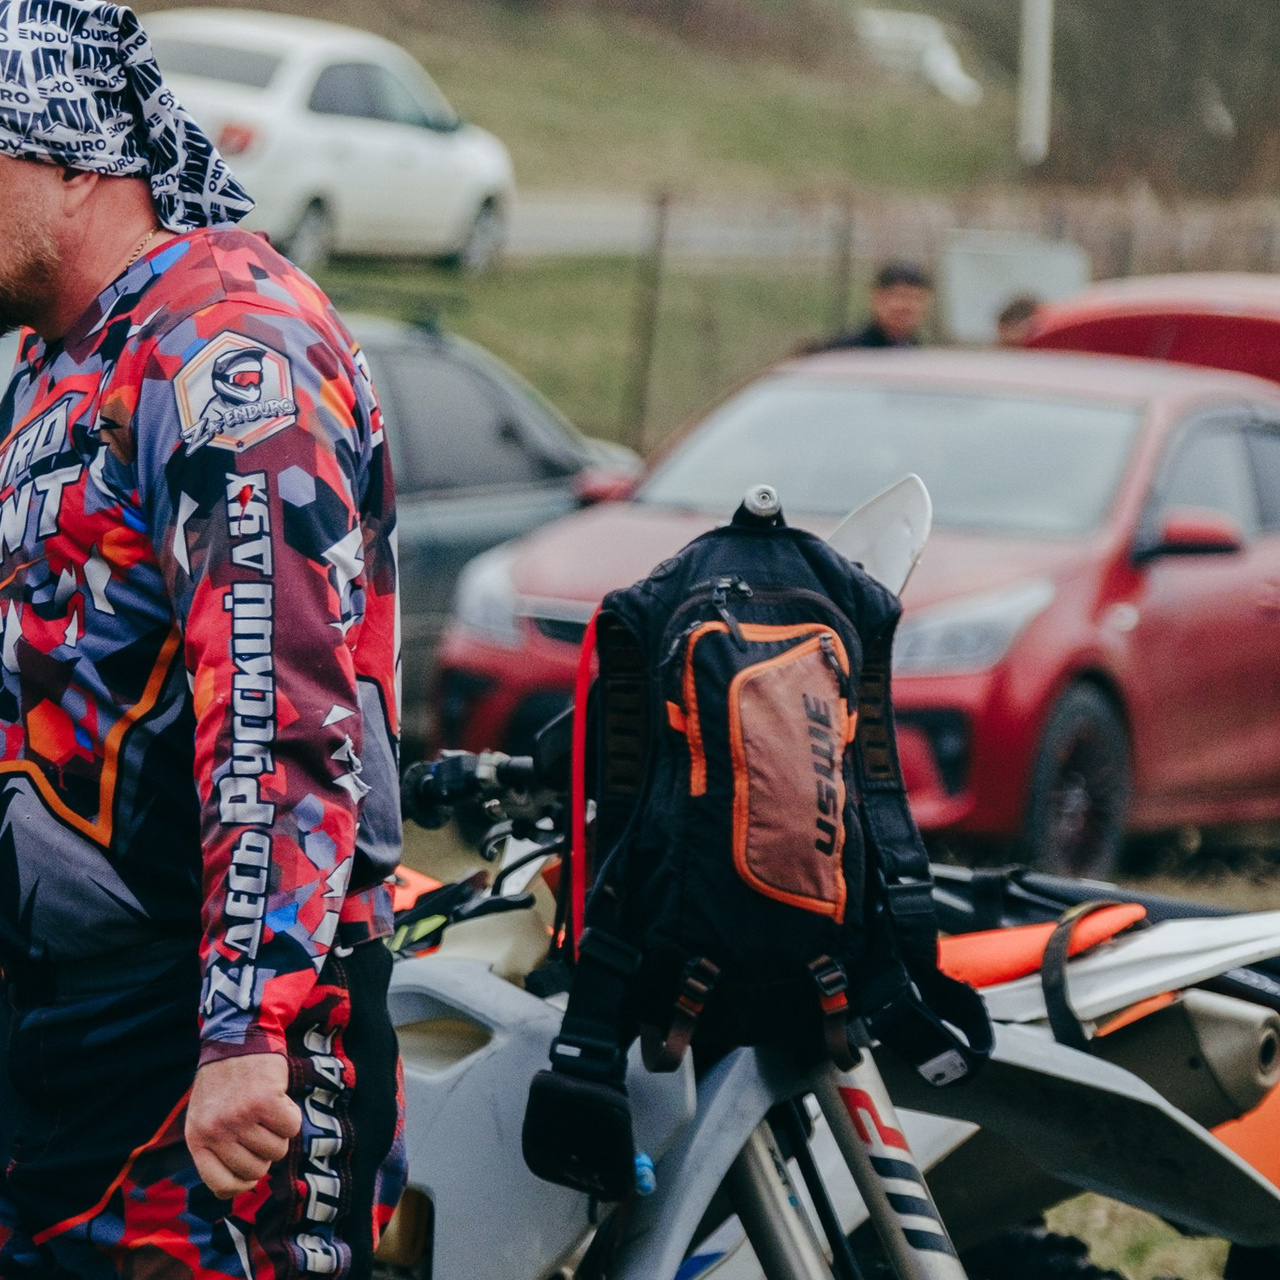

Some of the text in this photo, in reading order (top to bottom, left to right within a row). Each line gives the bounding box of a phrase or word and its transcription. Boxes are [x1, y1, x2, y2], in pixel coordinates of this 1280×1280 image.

[18, 28, 69, 44] ENDU
[80, 28, 120, 43] DURO
[94, 155, 136, 174] DURO
[223, 397, 297, 428] ENDURO
[801, 693, 838, 857] USWE
